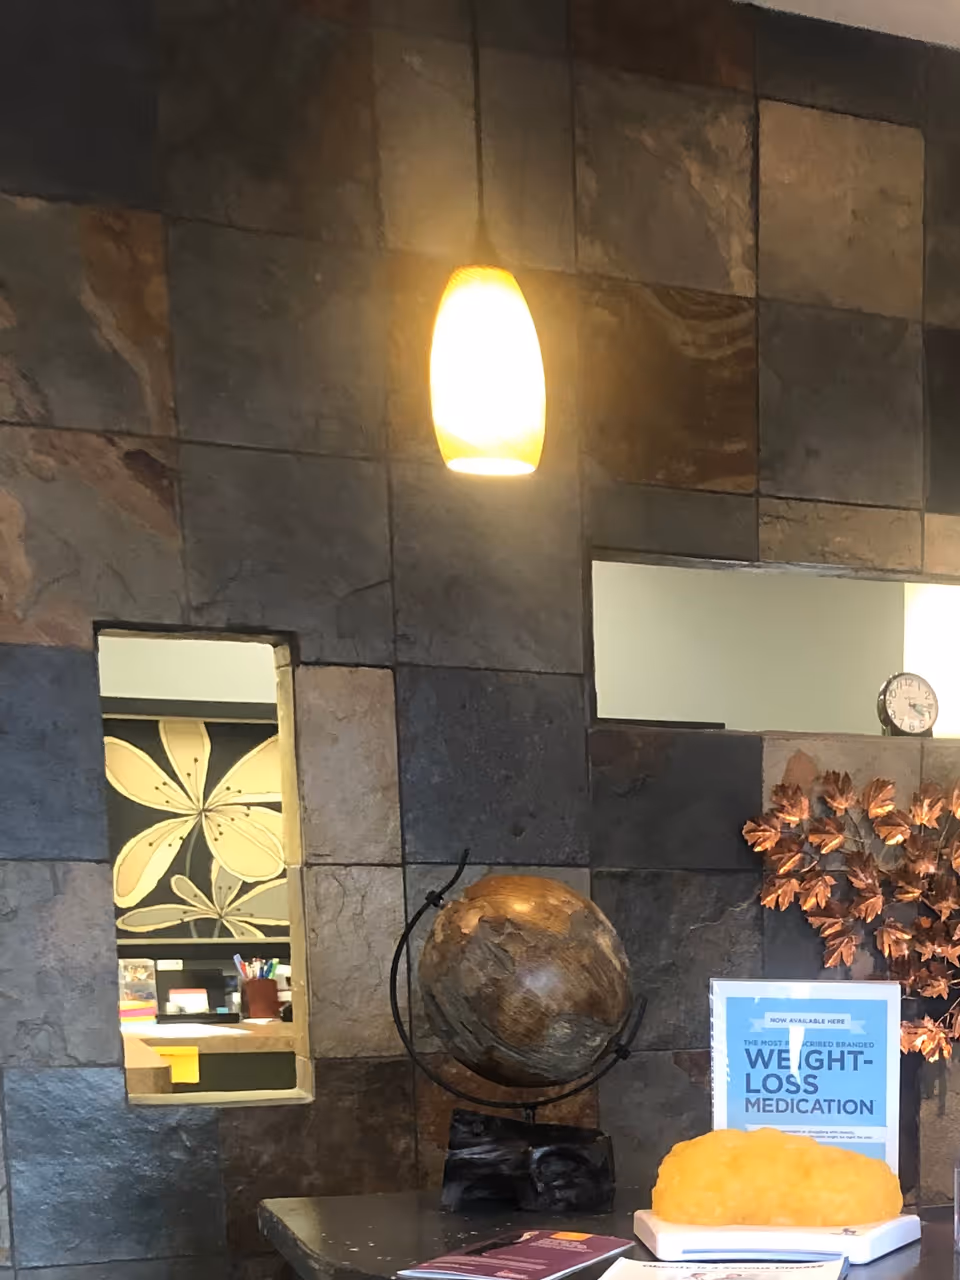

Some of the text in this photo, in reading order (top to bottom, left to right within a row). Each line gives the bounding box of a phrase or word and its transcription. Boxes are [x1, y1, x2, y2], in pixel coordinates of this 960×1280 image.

[835, 1041, 875, 1049] BRANDED
[745, 1073, 819, 1095] LOSS
[744, 1097, 875, 1116] MEDICATION
